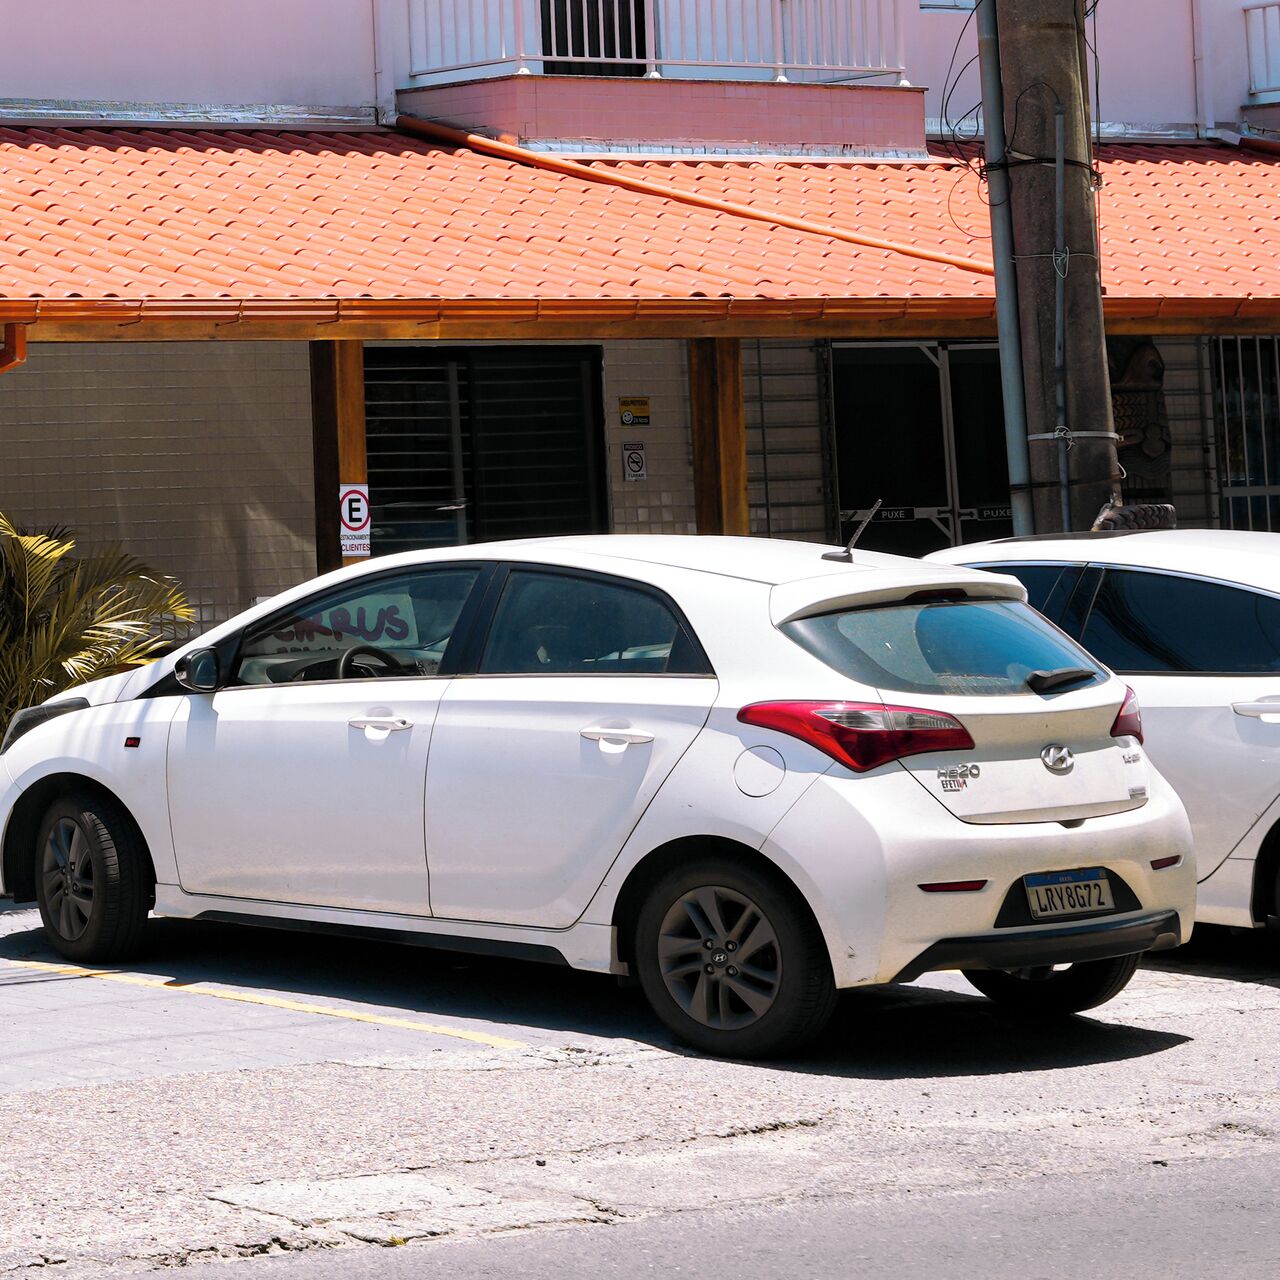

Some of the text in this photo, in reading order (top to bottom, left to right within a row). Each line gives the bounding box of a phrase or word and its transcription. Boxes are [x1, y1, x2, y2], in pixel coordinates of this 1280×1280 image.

[348, 498, 363, 523] E
[881, 510, 906, 519] PUXE
[341, 543, 371, 552] CLIENTES
[936, 764, 981, 780] HB20
[1035, 882, 1106, 913] LRY8G72
